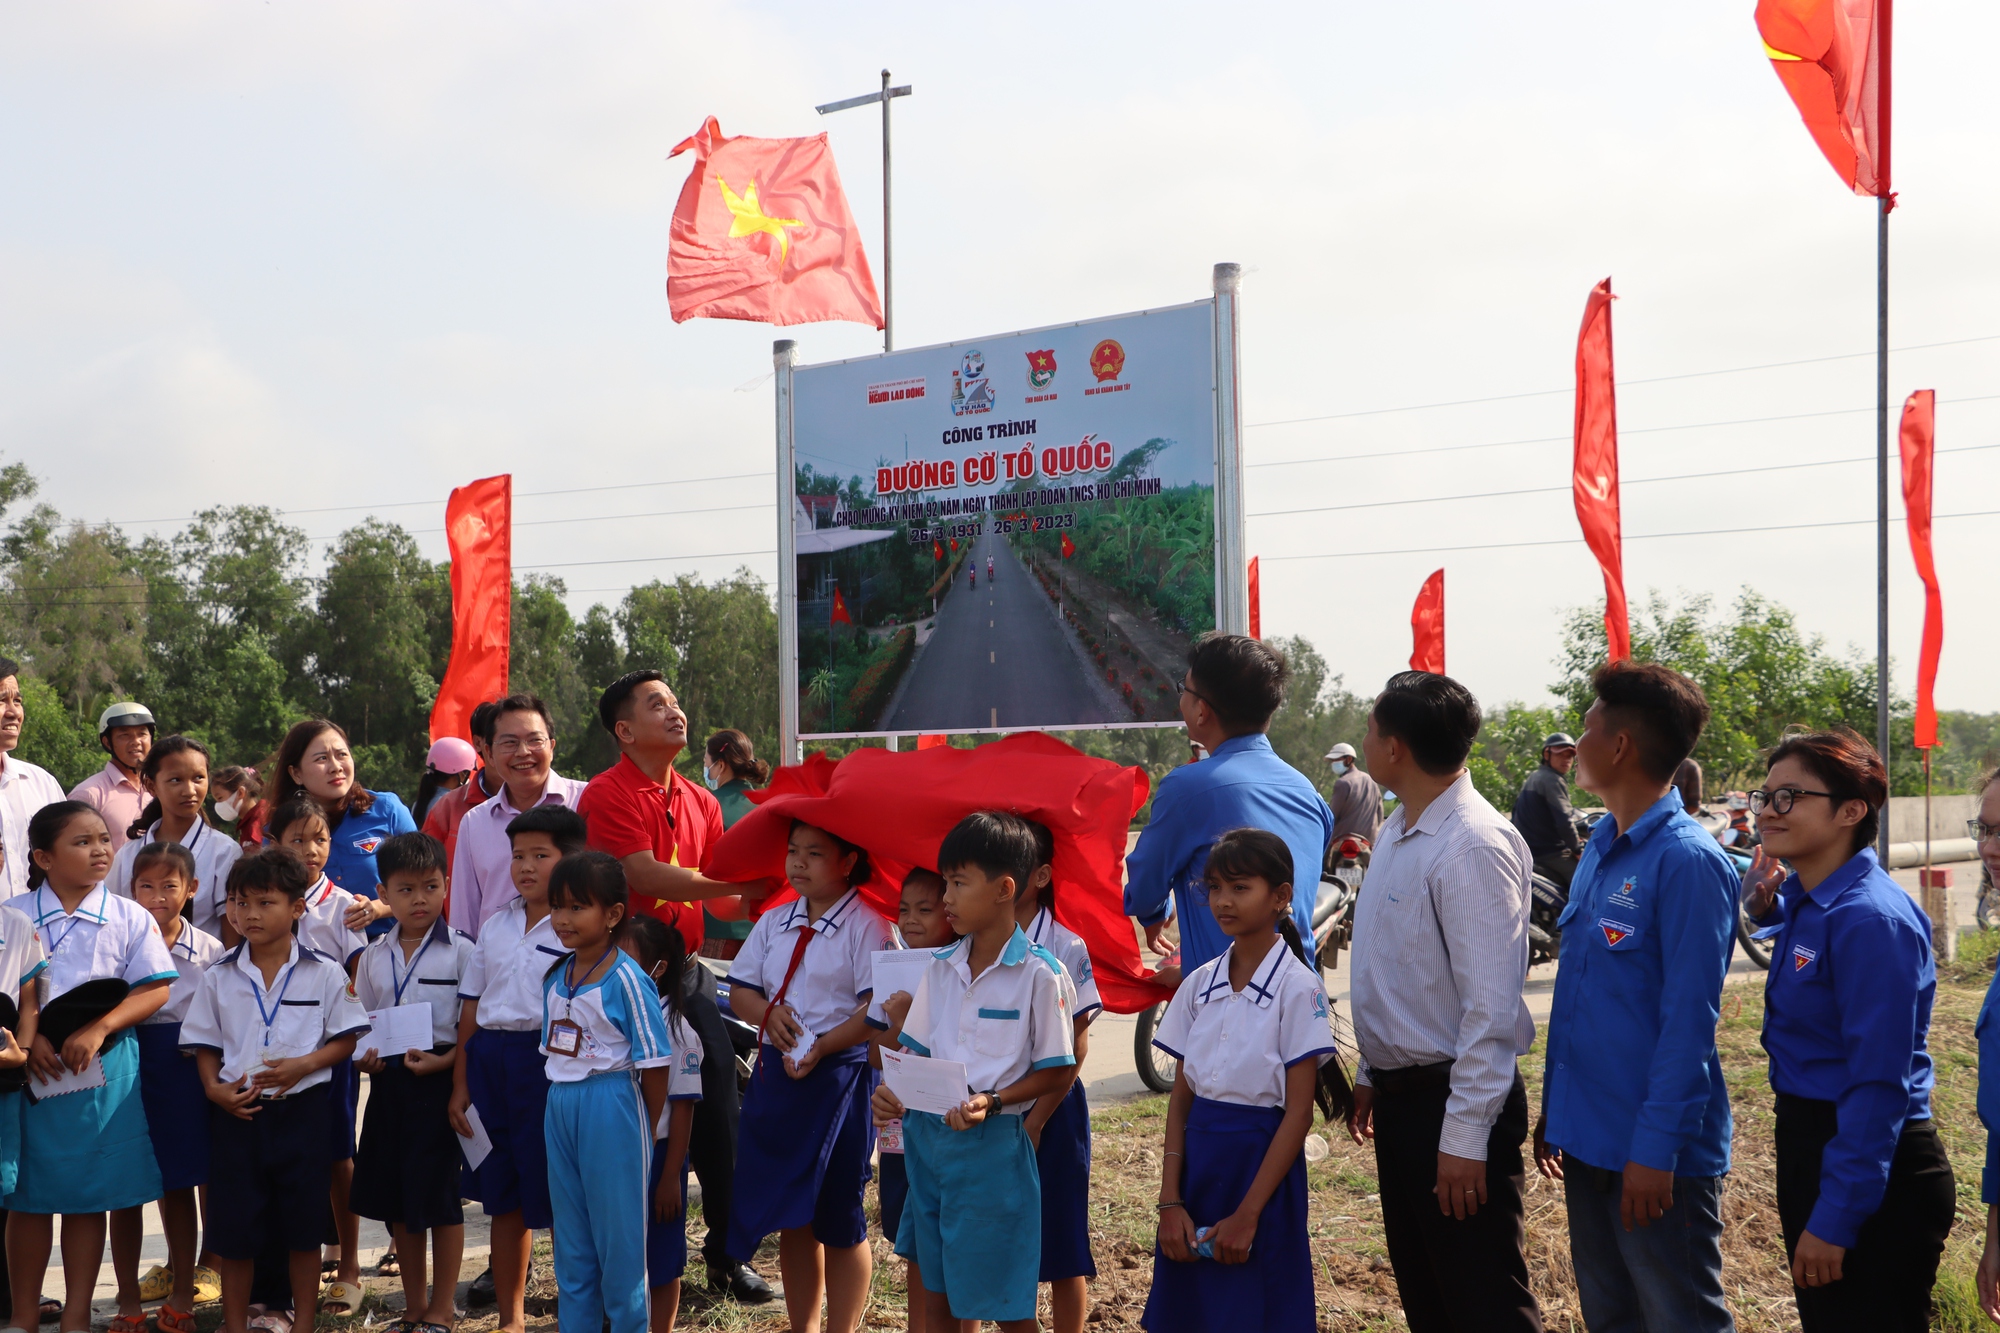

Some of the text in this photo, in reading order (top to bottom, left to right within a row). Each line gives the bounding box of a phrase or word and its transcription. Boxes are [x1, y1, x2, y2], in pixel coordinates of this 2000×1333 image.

[891, 389, 904, 401] LAO
[905, 386, 925, 399] ĐỘNG
[942, 419, 1037, 445] CÔNG TRÌNH
[877, 434, 1113, 493] ĐƯỜNG CỜ TỔ QUỐC
[902, 501, 924, 521] NIỆM
[926, 501, 938, 517] 92
[940, 497, 960, 516] NĂM
[962, 494, 986, 514] NGÀY
[988, 491, 1018, 511] THÀNH
[1021, 488, 1038, 509] LẬP
[1040, 485, 1066, 506] ĐOÀN
[1069, 484, 1094, 503] TNCS
[1097, 477, 1111, 500] HỒ
[1114, 477, 1131, 498] CHÍ
[1134, 477, 1161, 497] MINH
